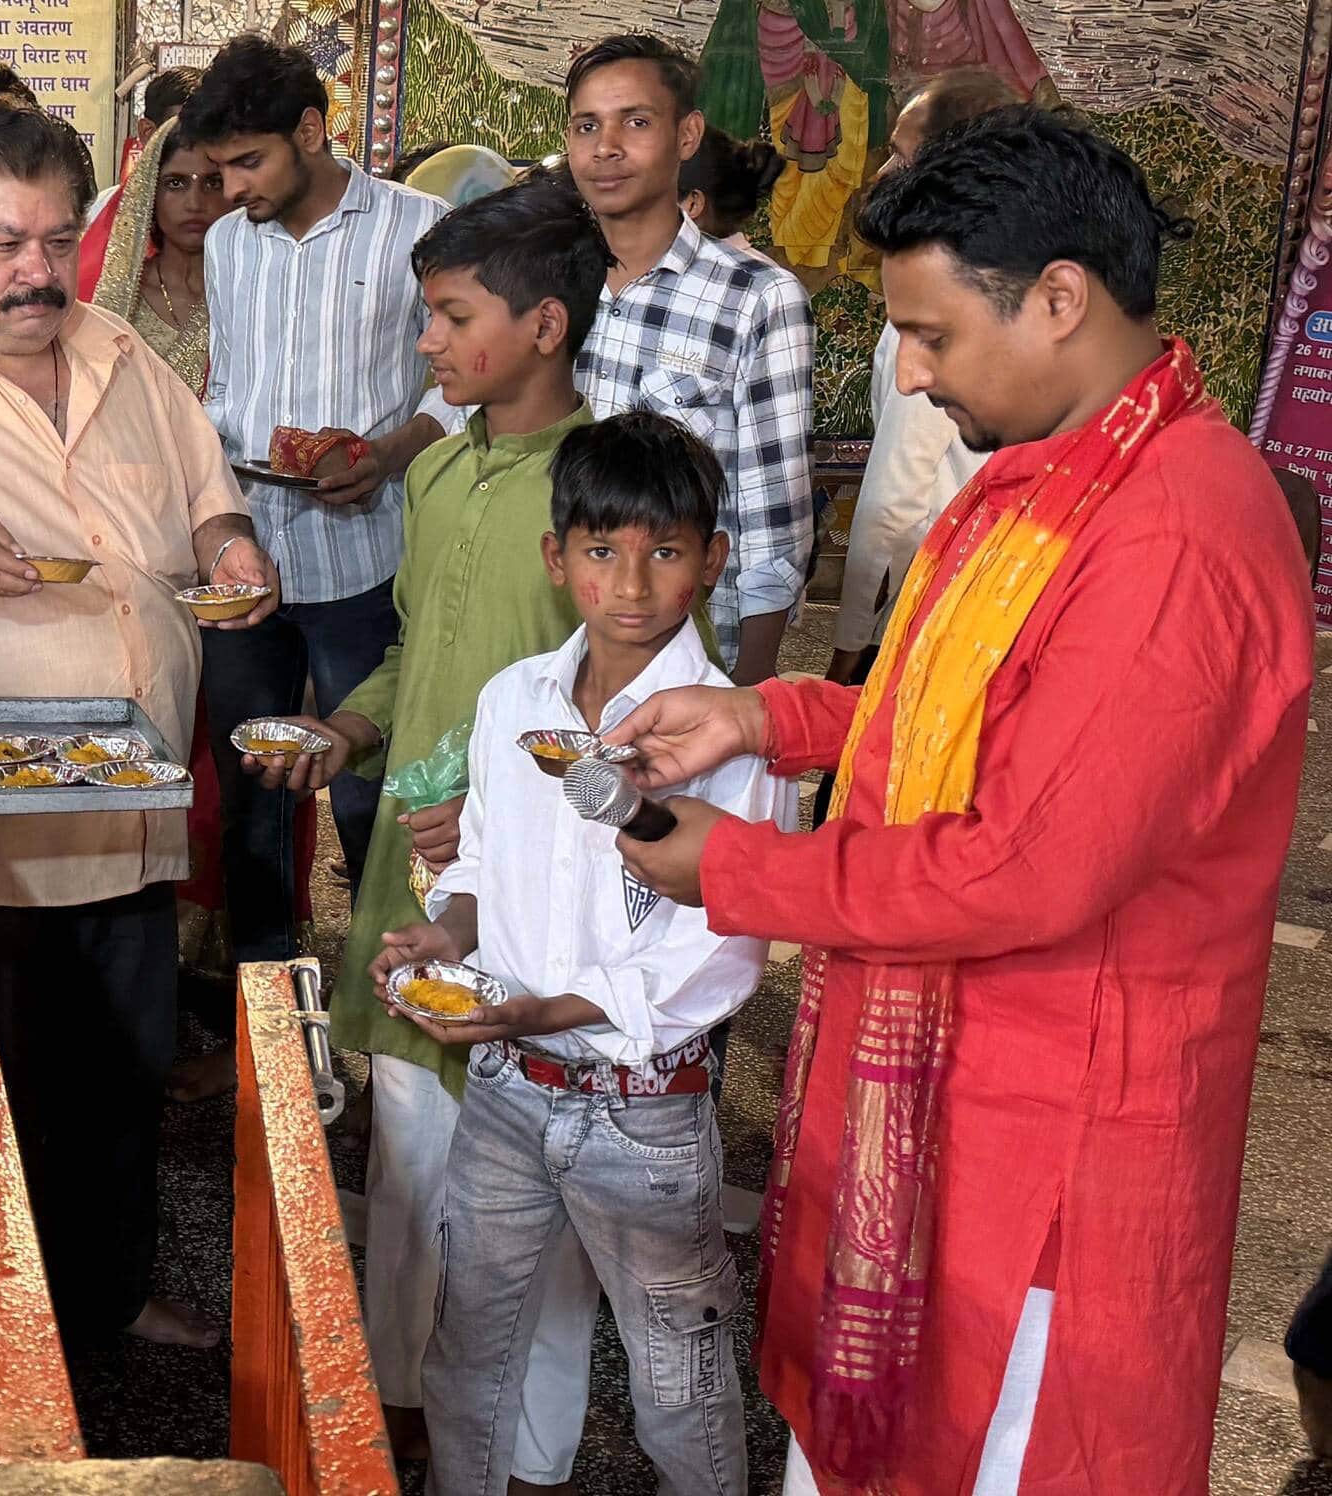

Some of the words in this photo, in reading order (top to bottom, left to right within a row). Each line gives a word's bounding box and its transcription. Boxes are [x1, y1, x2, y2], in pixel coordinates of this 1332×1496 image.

[15, 20, 73, 36] अवतरण
[23, 44, 61, 64] विराट
[65, 49, 87, 64] रूप
[61, 77, 91, 91] धाम
[1295, 343, 1312, 356] 26
[1266, 440, 1282, 452] 26
[1295, 445, 1312, 457] 27
